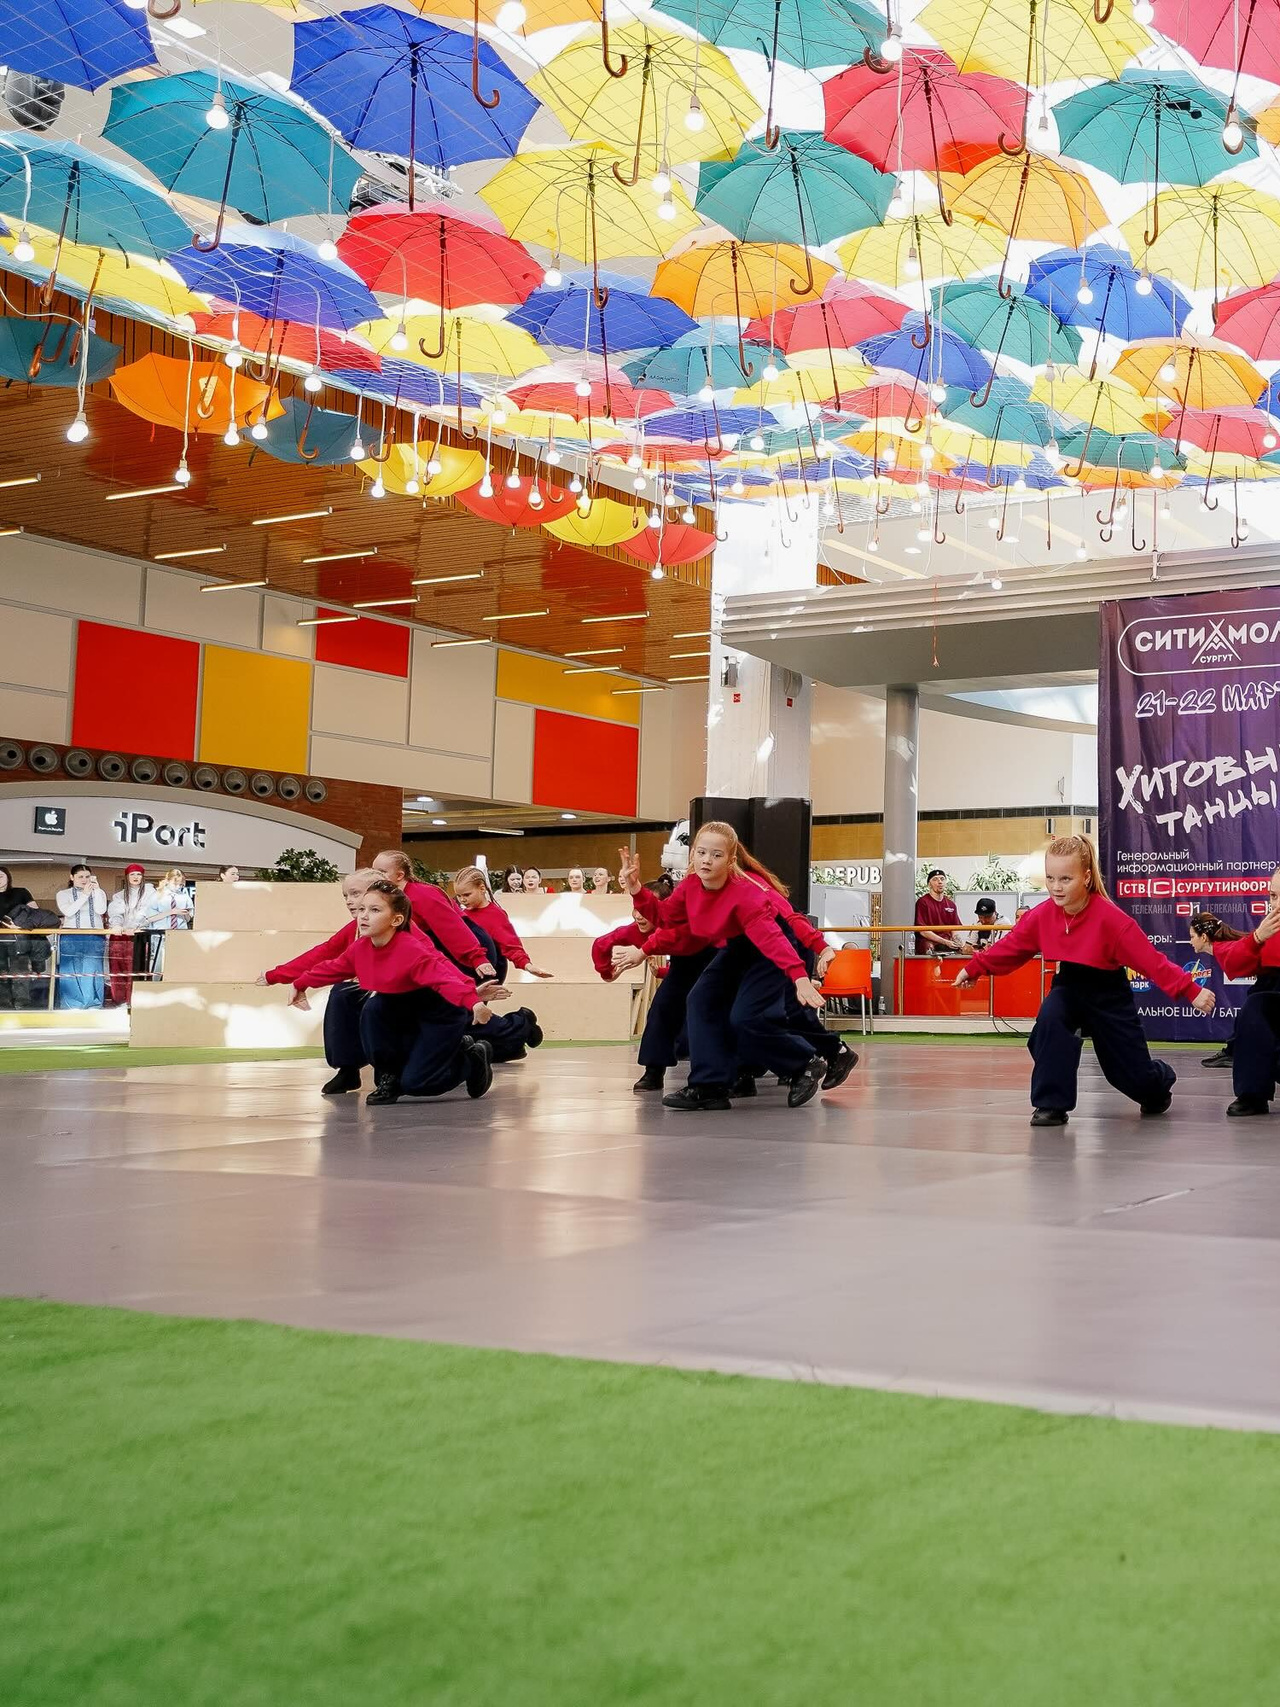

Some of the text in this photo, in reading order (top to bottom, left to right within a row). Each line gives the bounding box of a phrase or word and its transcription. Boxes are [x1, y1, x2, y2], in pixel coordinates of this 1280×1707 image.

[1135, 628, 1205, 653] СИТИ
[1199, 652, 1234, 665] СУРГУТ
[1135, 689, 1217, 718] 21-22
[112, 811, 207, 849] iPort
[1117, 849, 1190, 862] Генеральный
[1117, 858, 1280, 874] информационный партнер:
[1177, 879, 1271, 894] СУРГУТИНФОР
[1131, 904, 1173, 915] ТЕЛЕКАНАЛ
[1206, 903, 1248, 914] ТЕЛЕКАНАЛ
[1137, 1006, 1180, 1017] АЛЬНОЕ
